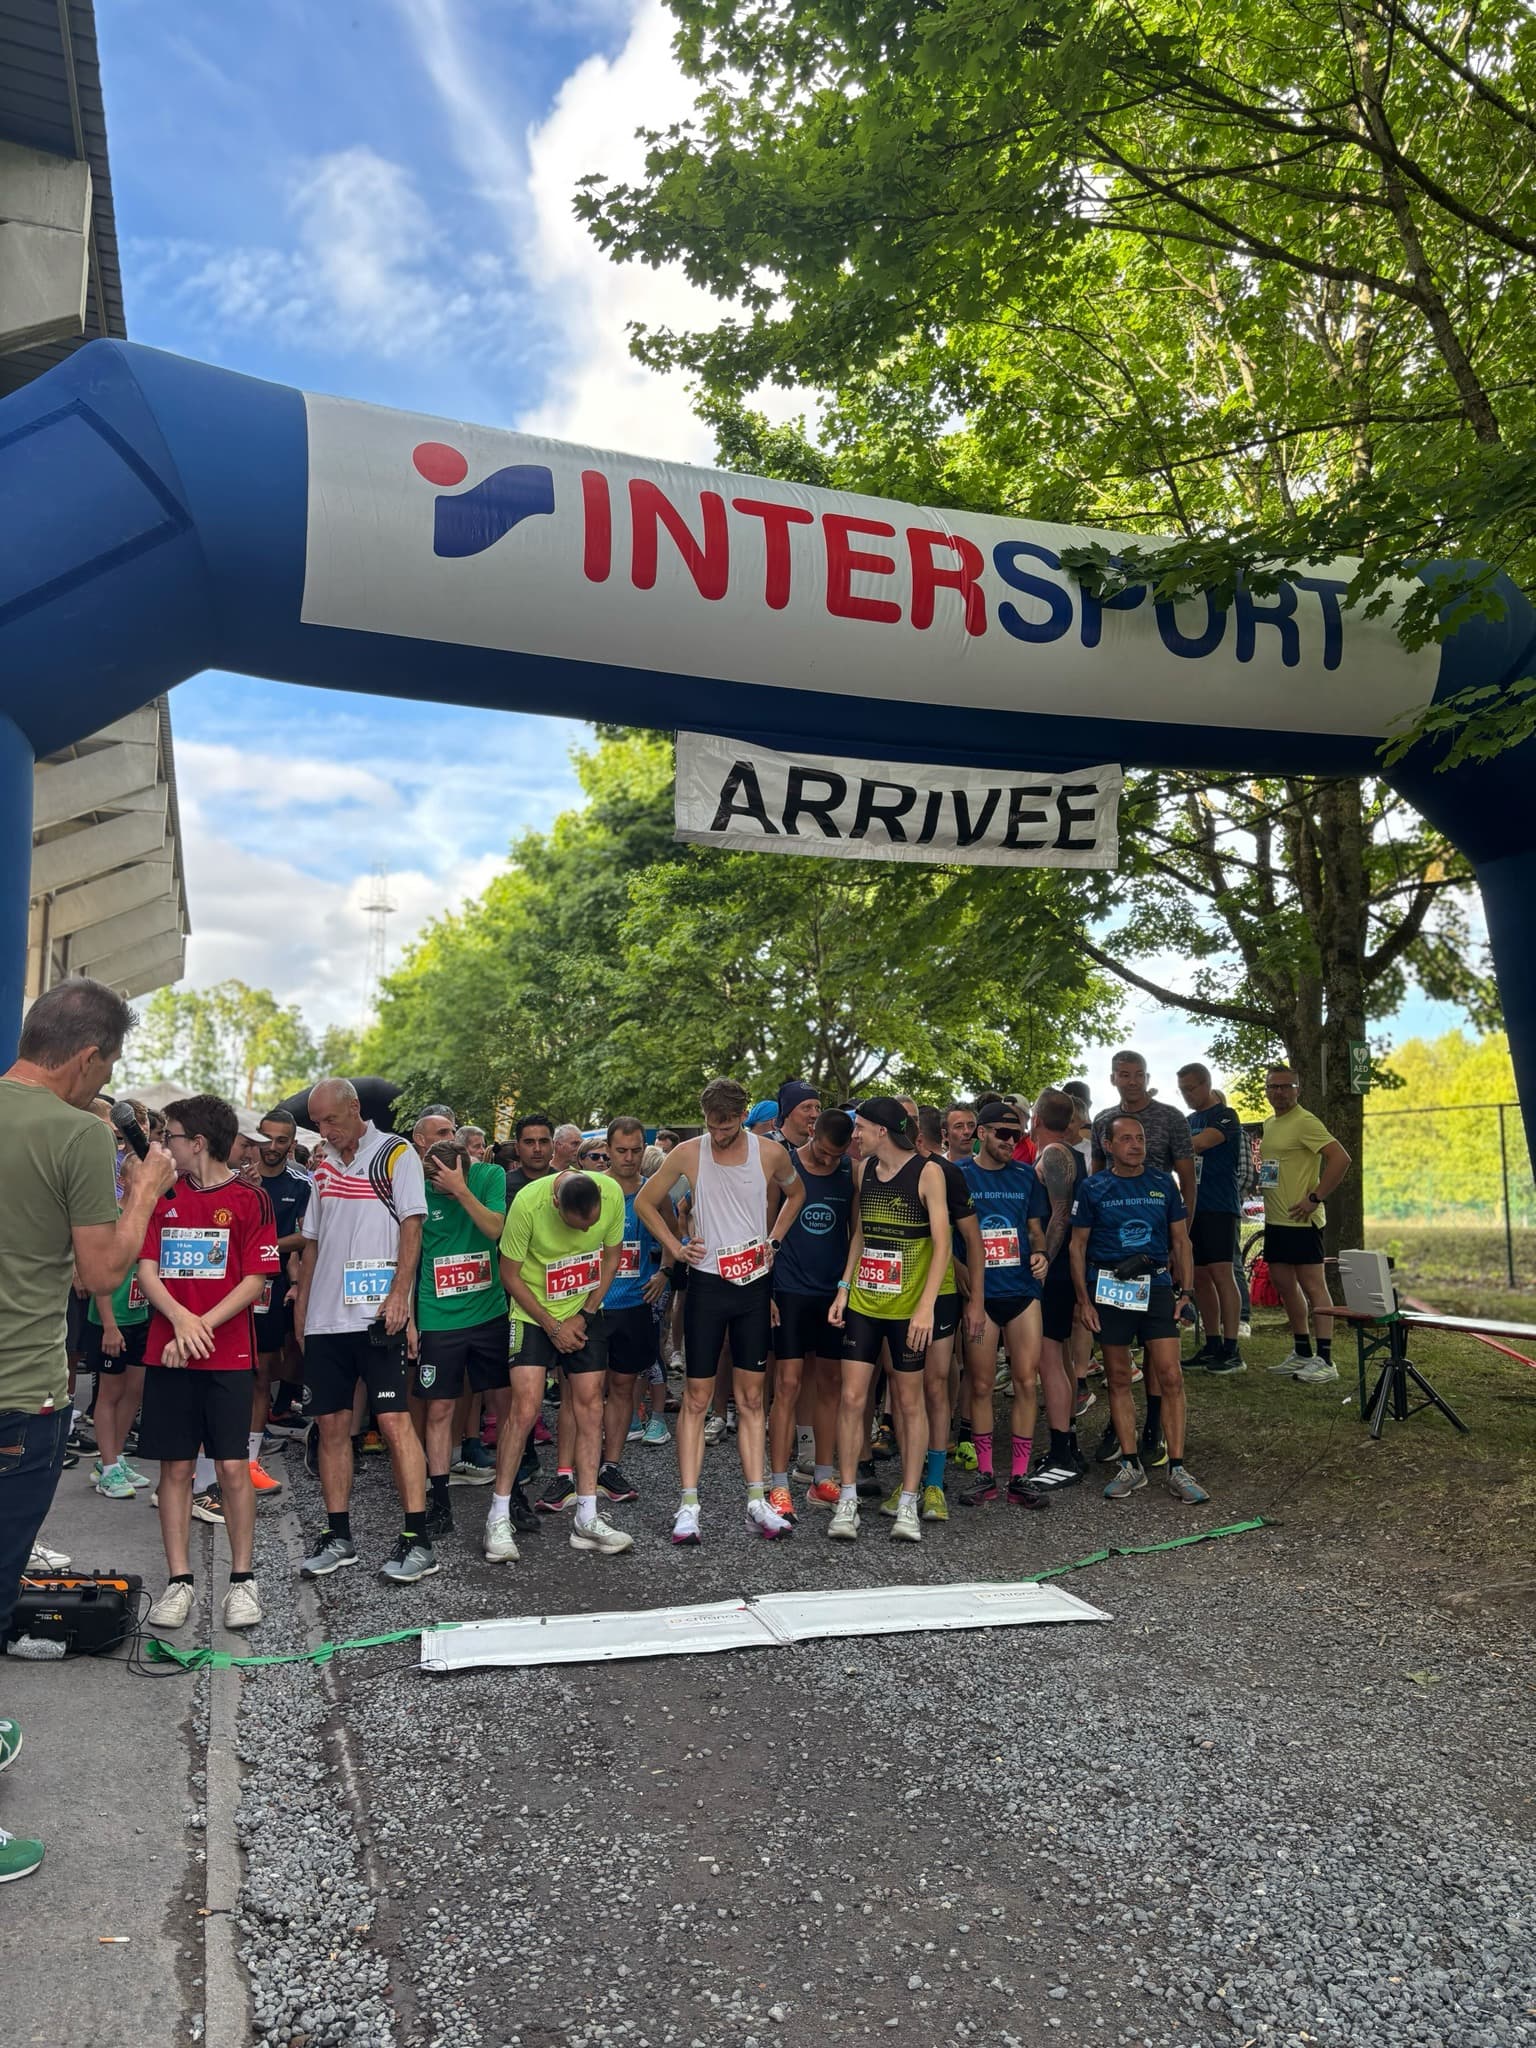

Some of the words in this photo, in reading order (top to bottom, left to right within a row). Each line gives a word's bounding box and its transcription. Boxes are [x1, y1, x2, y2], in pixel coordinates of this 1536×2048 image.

[710, 760, 1099, 850] ARRIVEE
[1102, 1199, 1123, 1208] TEAM
[804, 1210, 832, 1220] cora
[164, 1251, 204, 1265] 1389
[724, 1258, 753, 1278] 2055
[860, 1266, 884, 1281] 2058
[350, 1279, 388, 1293] 1617
[439, 1271, 474, 1287] 2150
[552, 1273, 583, 1291] 1791
[1101, 1285, 1133, 1301] 1610
[377, 1391, 396, 1399] JAKO
